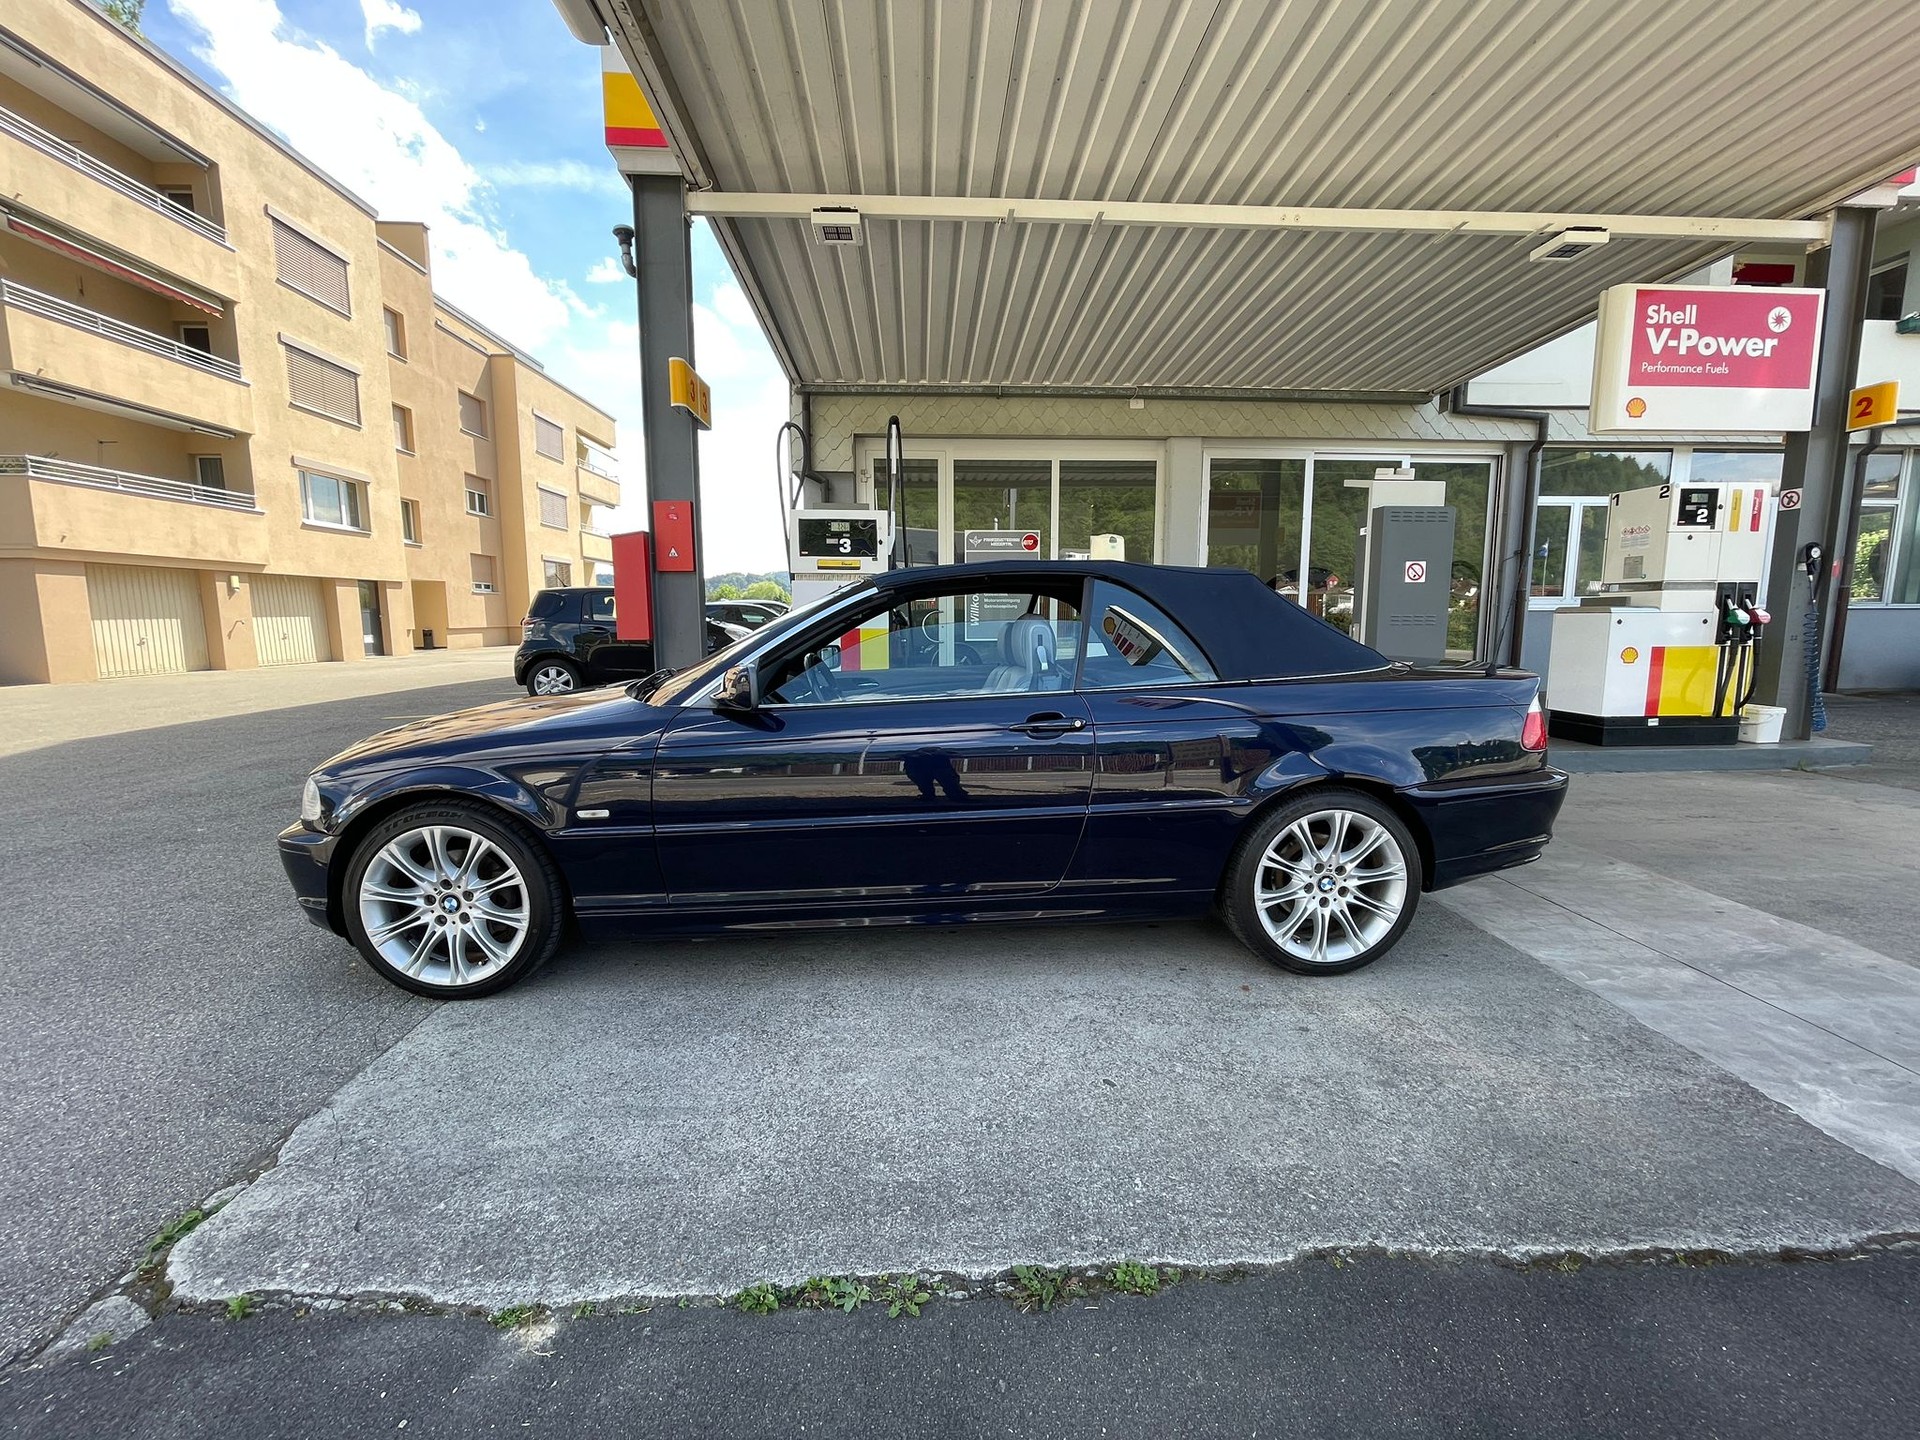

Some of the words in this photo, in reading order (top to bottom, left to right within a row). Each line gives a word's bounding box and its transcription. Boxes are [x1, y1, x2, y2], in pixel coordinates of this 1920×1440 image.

[1646, 303, 1697, 325] Shell
[1645, 327, 1778, 357] V-Power
[1641, 361, 1702, 374] Performance
[1705, 362, 1729, 374] Fuels
[1855, 396, 1873, 419] 2
[1659, 485, 1670, 500] 2
[1612, 494, 1620, 507] 1
[1696, 508, 1708, 523] 2
[839, 538, 851, 553] 3
[970, 593, 980, 626] Willko
